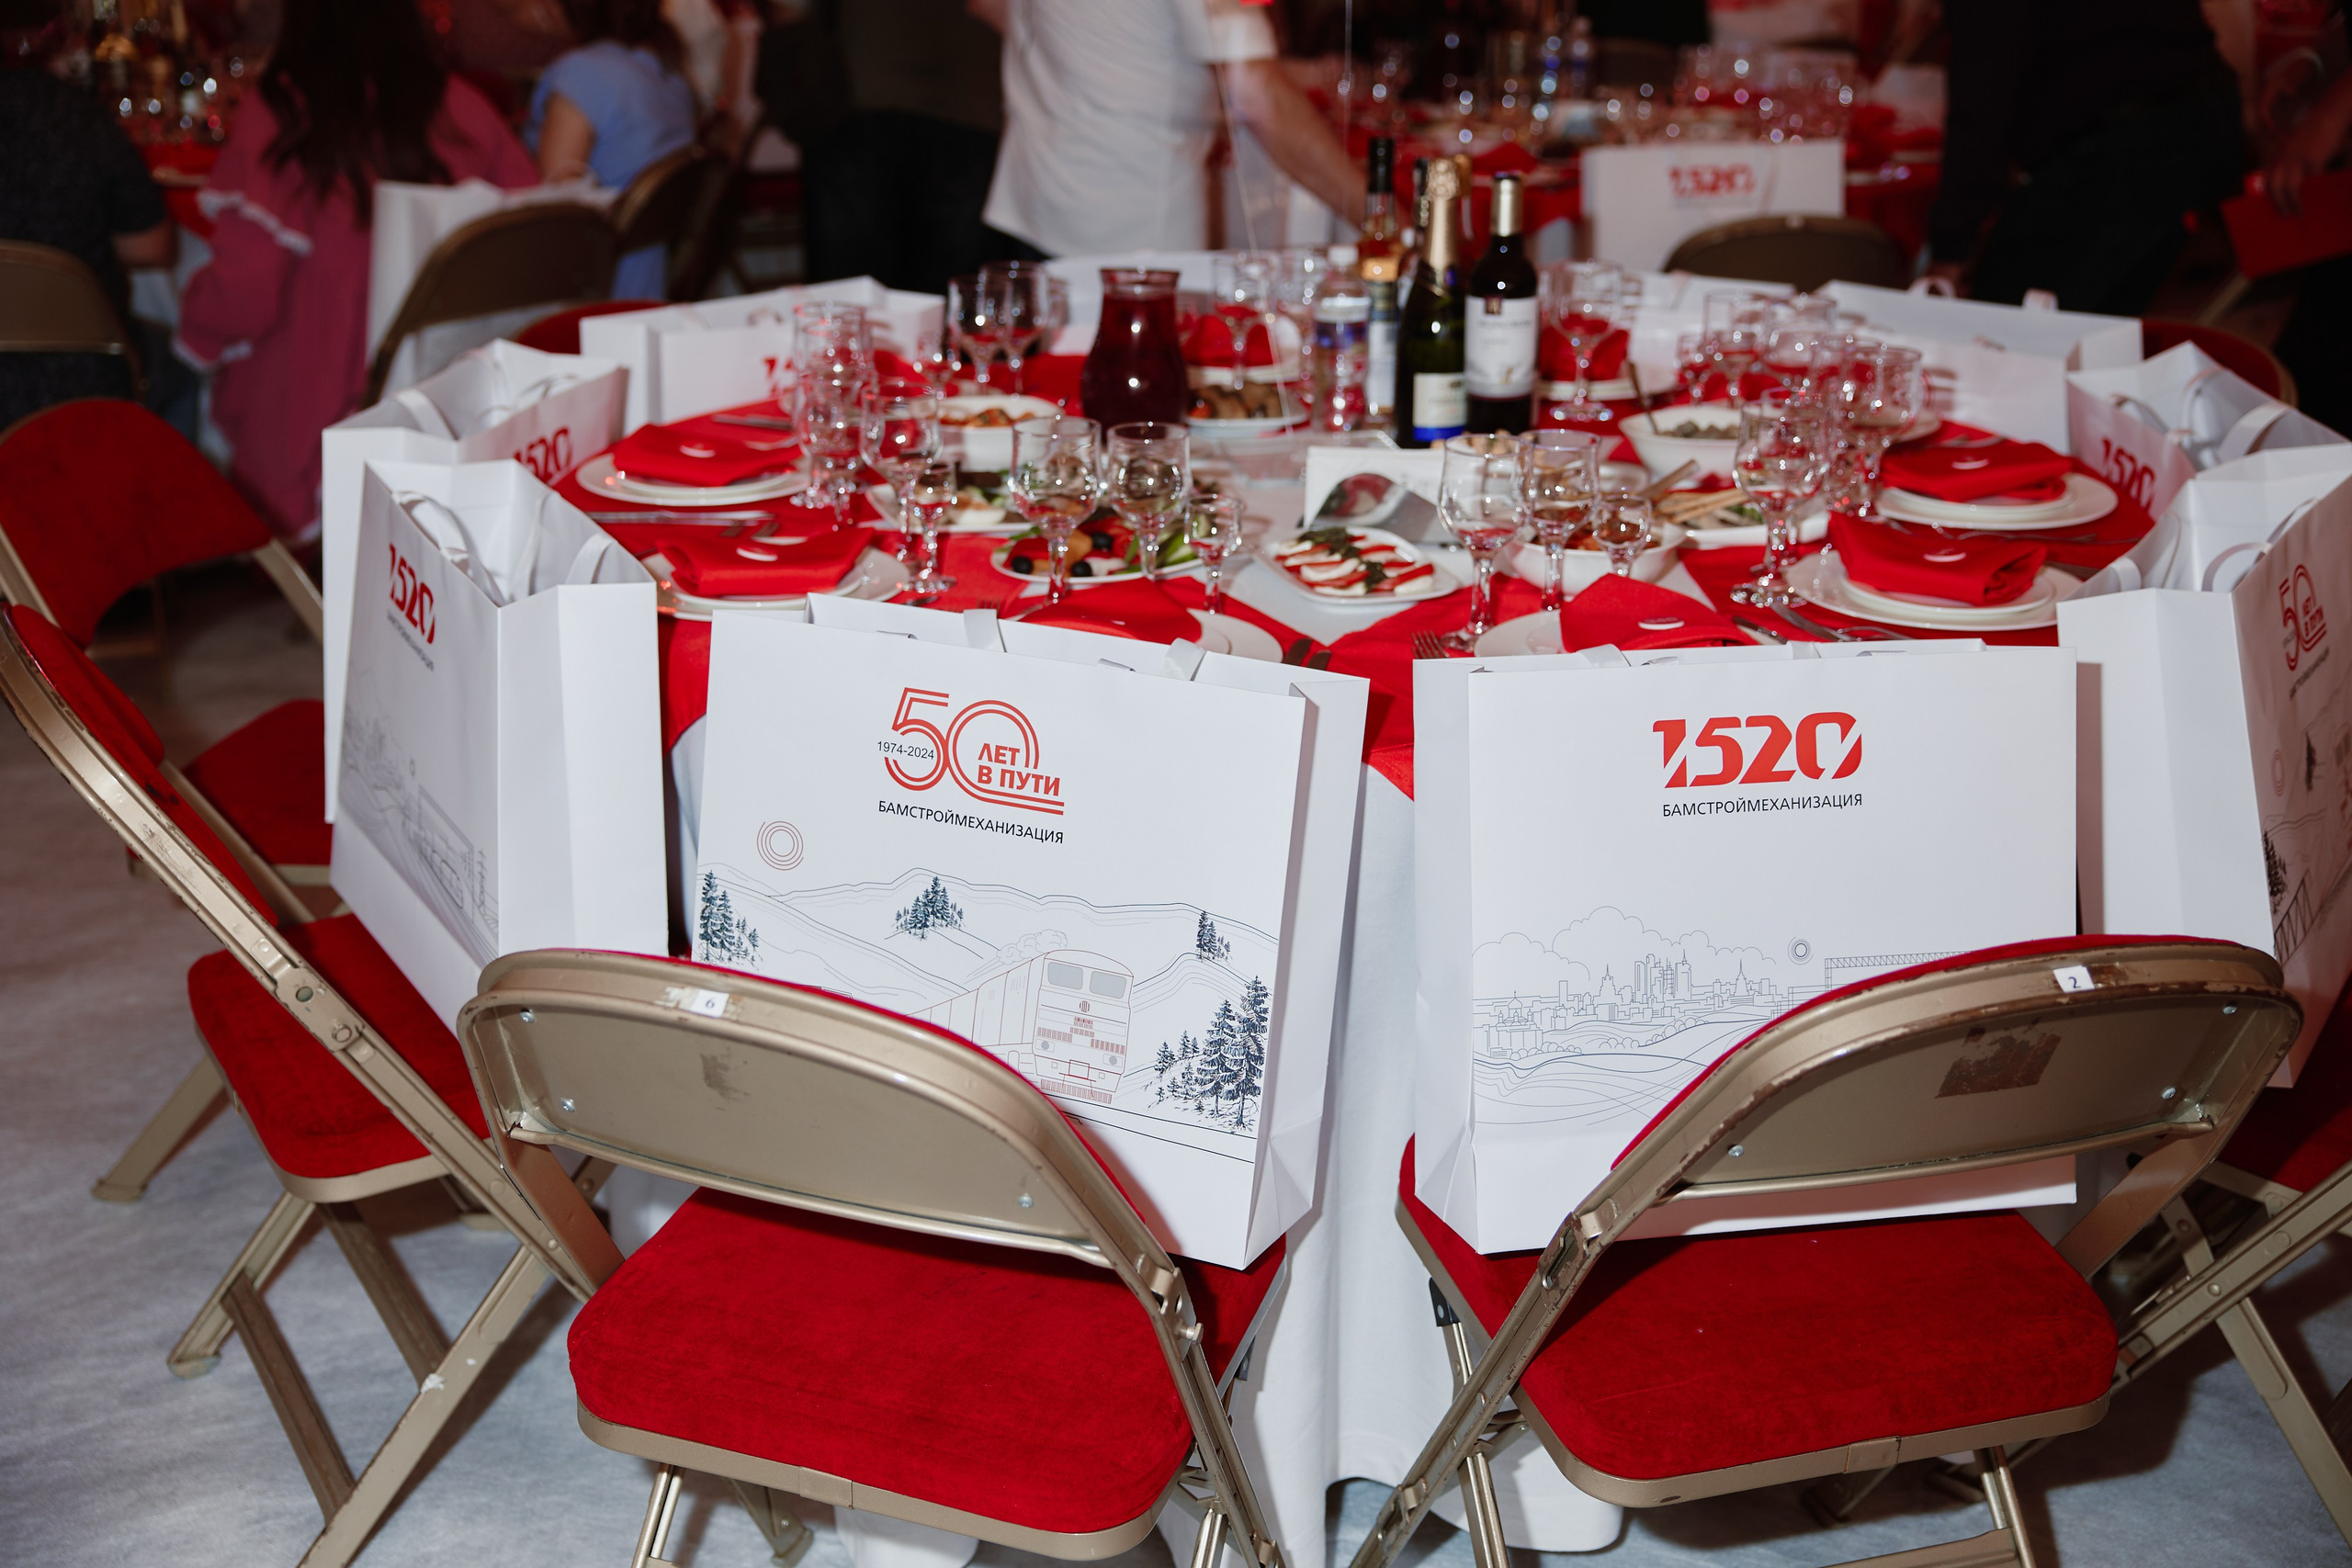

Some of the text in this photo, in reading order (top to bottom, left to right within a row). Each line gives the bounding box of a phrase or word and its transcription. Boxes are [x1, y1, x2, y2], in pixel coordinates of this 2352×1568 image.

[389, 541, 435, 645] 1520
[877, 741, 934, 760] 1974-2024
[884, 687, 1064, 815] 50
[978, 742, 1020, 766] ЛЕТ
[1653, 712, 1862, 788] 1520
[977, 764, 1060, 796] В ПУТИ
[1663, 794, 1862, 817] БАМСТРОЙМЕХАНИЗАЦИЯ
[878, 800, 1064, 843] БАМСТРОЙМЕХАНИЗАЦИЯ
[2068, 976, 2081, 988] 2
[706, 997, 715, 1009] 6
